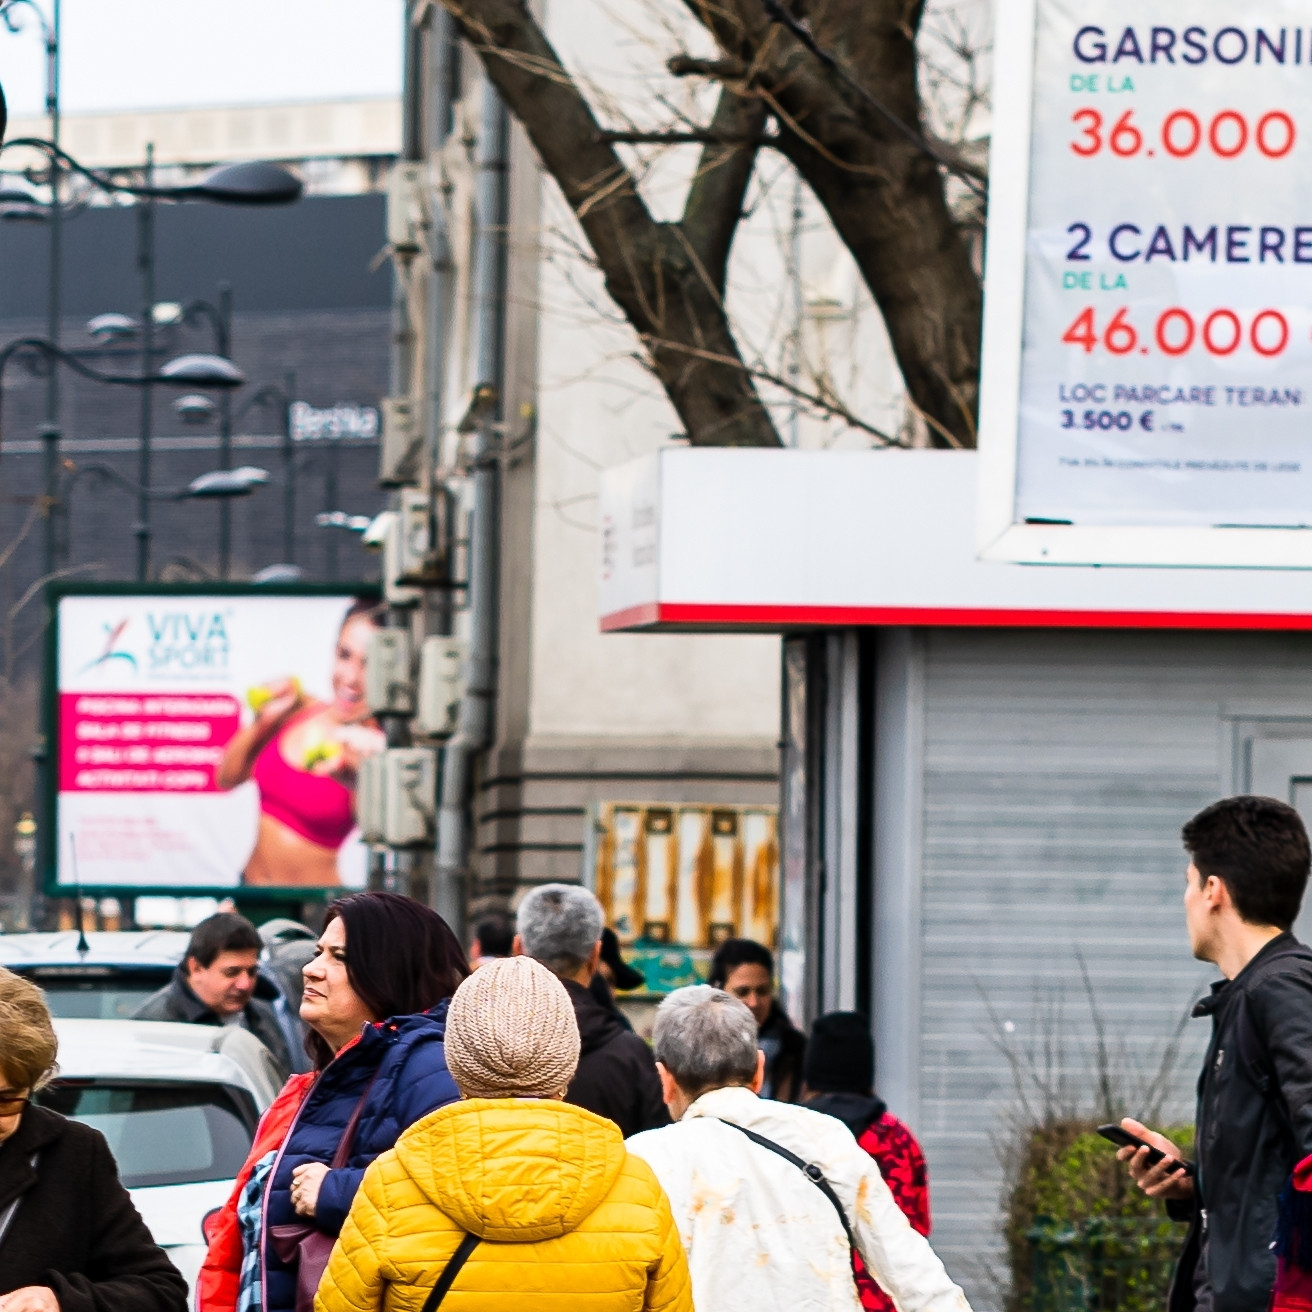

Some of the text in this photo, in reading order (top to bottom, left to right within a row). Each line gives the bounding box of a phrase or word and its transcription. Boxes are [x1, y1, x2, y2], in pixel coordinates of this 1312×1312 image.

[1069, 74, 1135, 93] DE LA
[1070, 107, 1296, 160] 36.000
[1066, 223, 1092, 261] 2
[1062, 271, 1128, 291] DE LA
[1061, 305, 1290, 357] 46.000
[1059, 384, 1107, 403] LOC
[1113, 385, 1215, 406] PARCARE
[1061, 409, 1133, 431] 3.500
[1139, 410, 1155, 432] €
[146, 611, 228, 642] VIVA
[147, 645, 231, 669] SPORT
